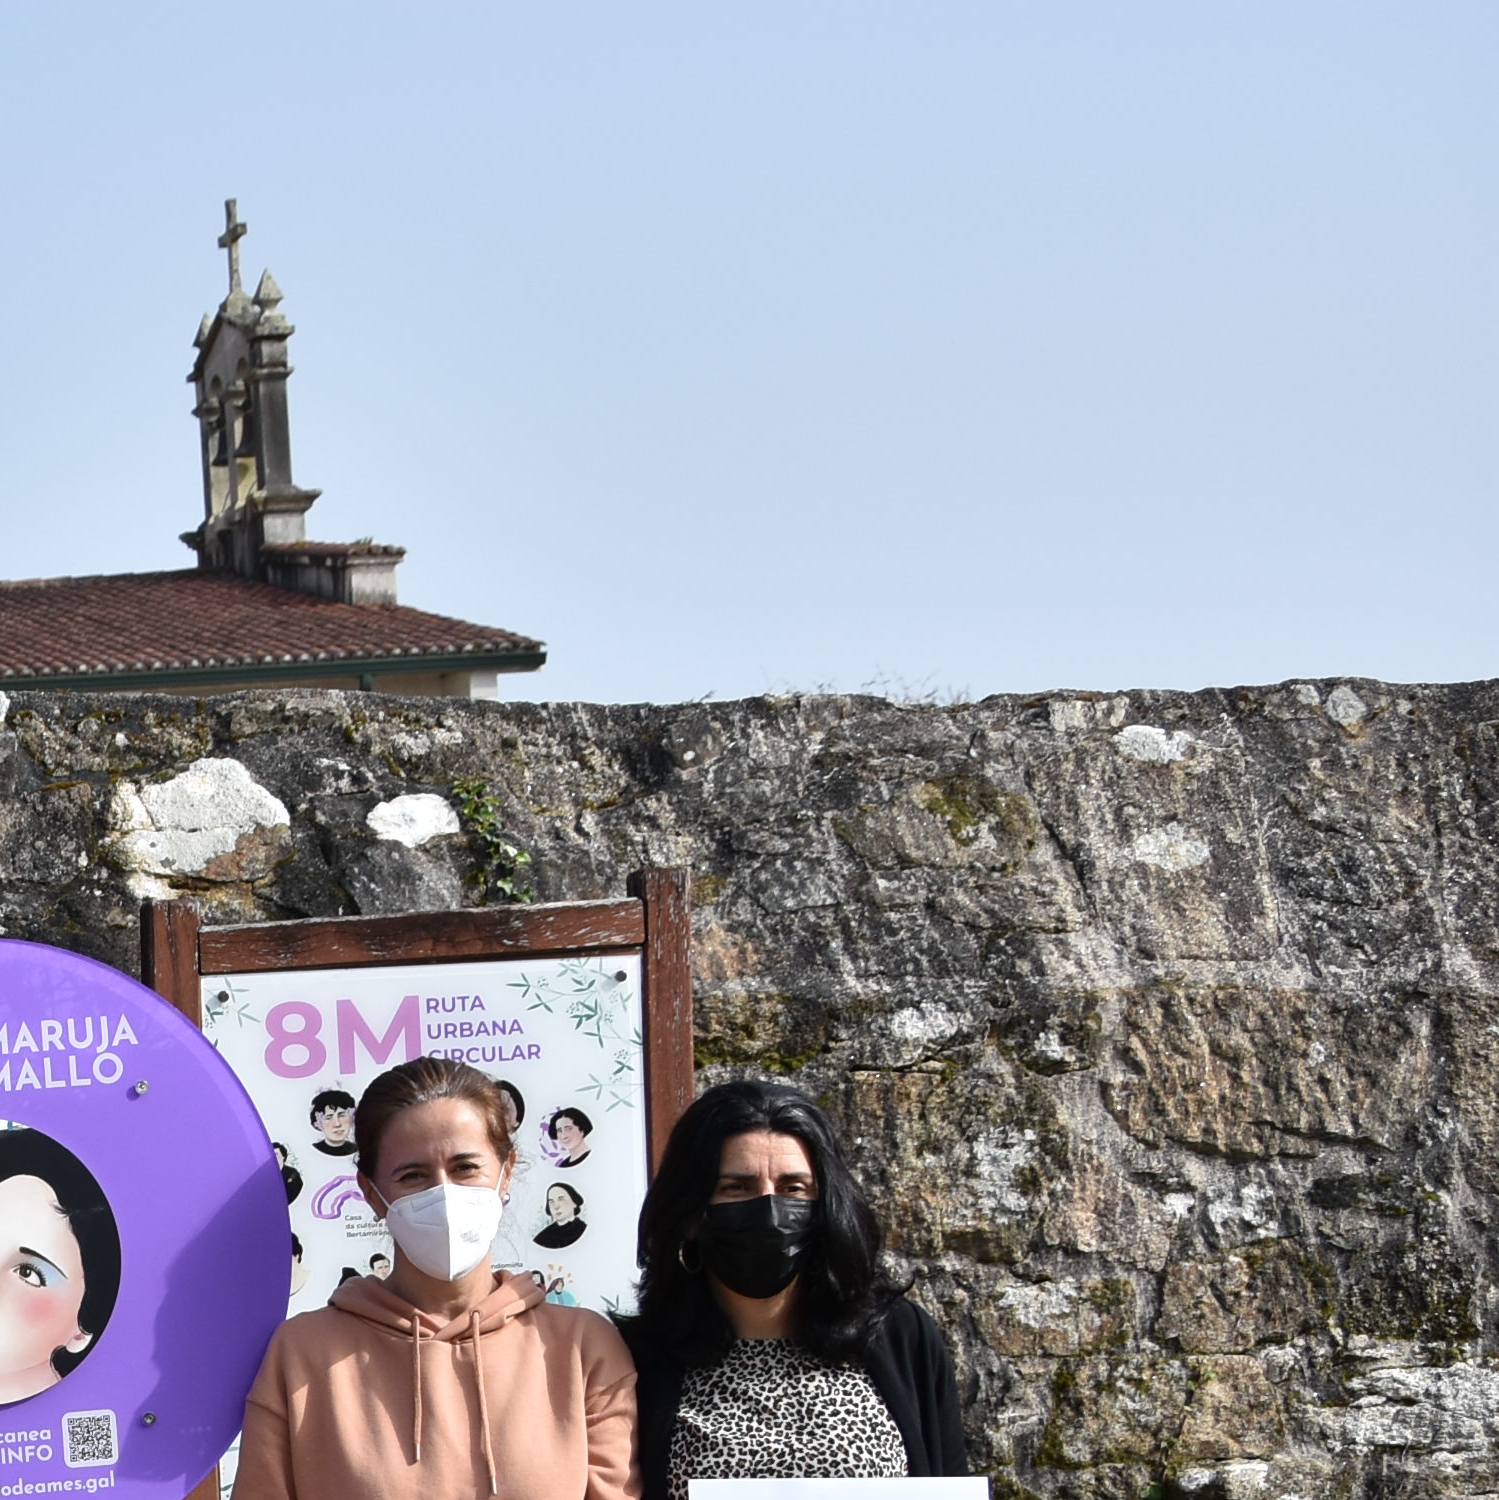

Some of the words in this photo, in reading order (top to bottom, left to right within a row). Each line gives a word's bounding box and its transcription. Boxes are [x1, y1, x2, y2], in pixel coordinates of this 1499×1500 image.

[426, 995, 485, 1014] RUTA
[264, 995, 421, 1079] 8M
[427, 1019, 524, 1039] URBANA
